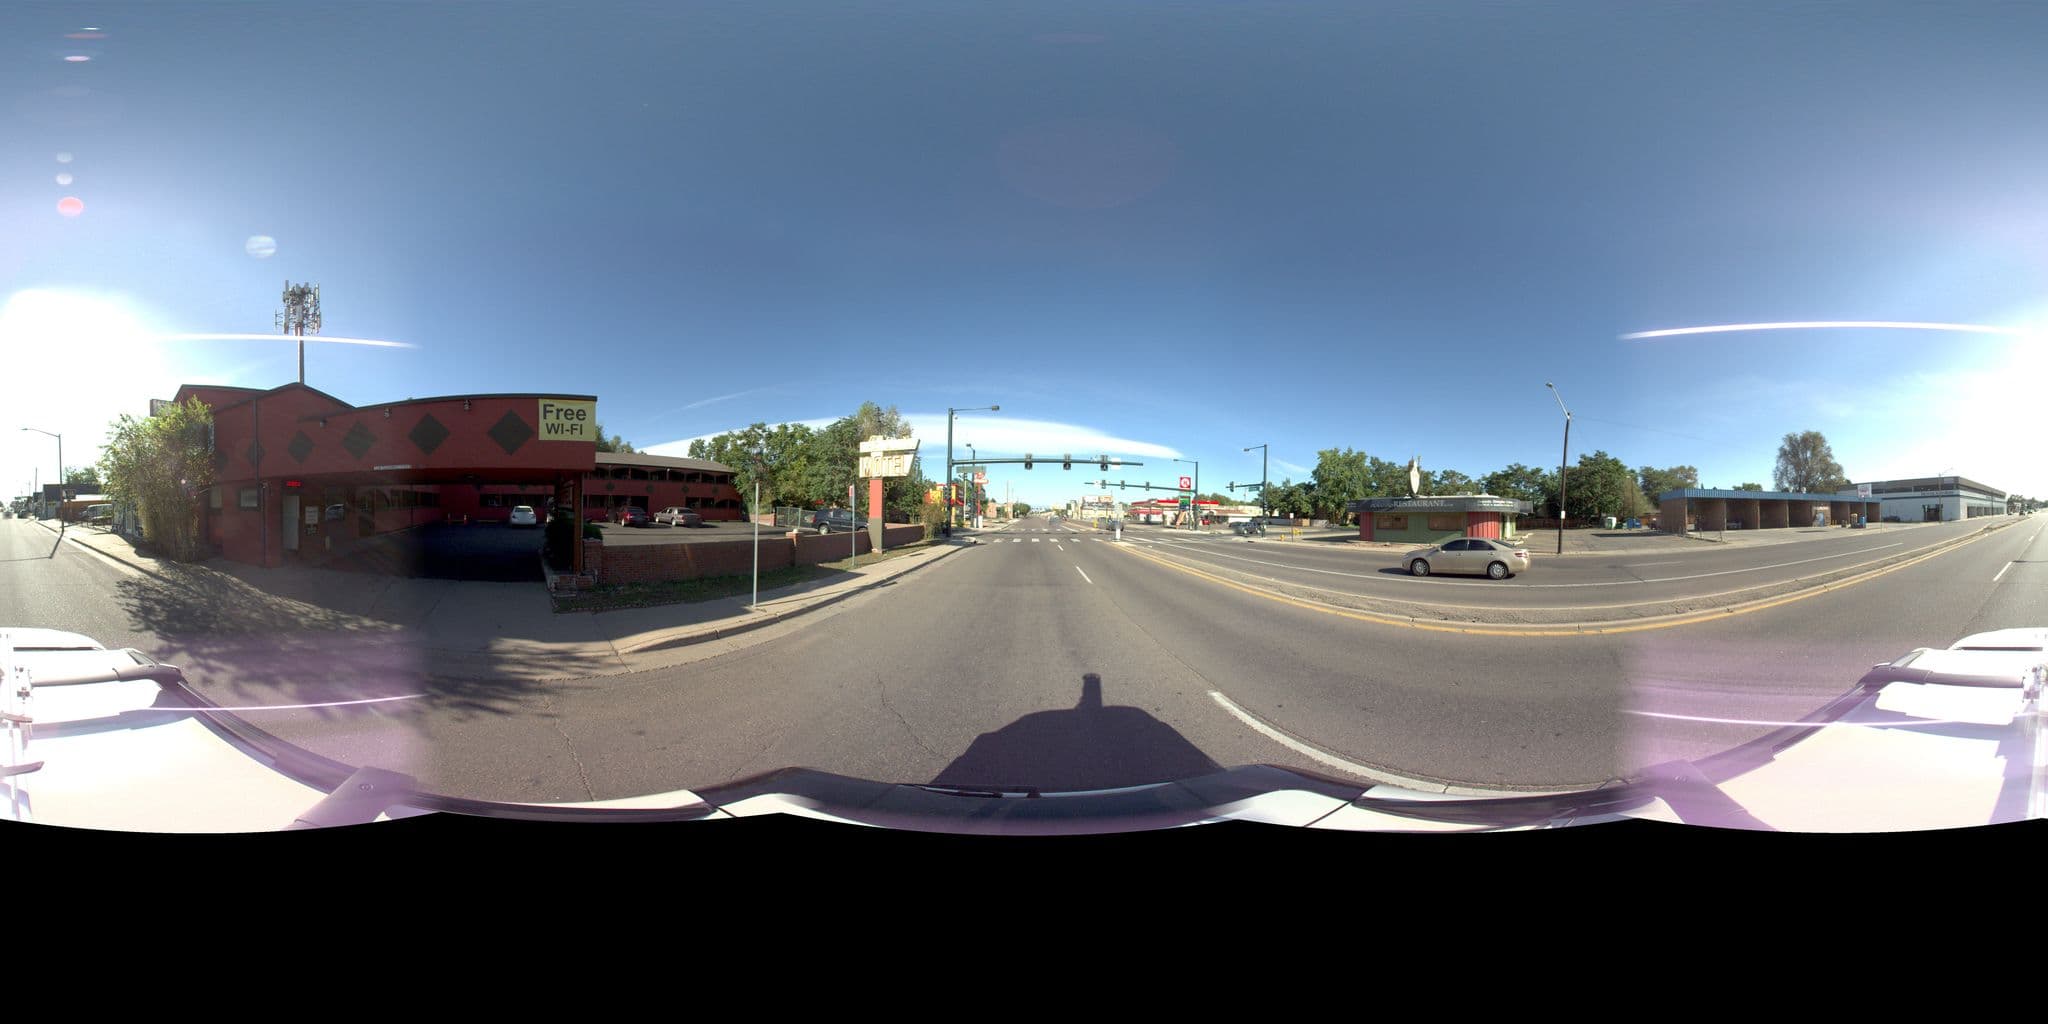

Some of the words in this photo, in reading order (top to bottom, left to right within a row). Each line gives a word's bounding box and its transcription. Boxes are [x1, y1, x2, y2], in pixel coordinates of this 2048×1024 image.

[543, 403, 587, 421] Free
[545, 423, 583, 435] WI-FI
[860, 454, 908, 477] MOTEL
[1393, 500, 1444, 508] RESTAURANT
